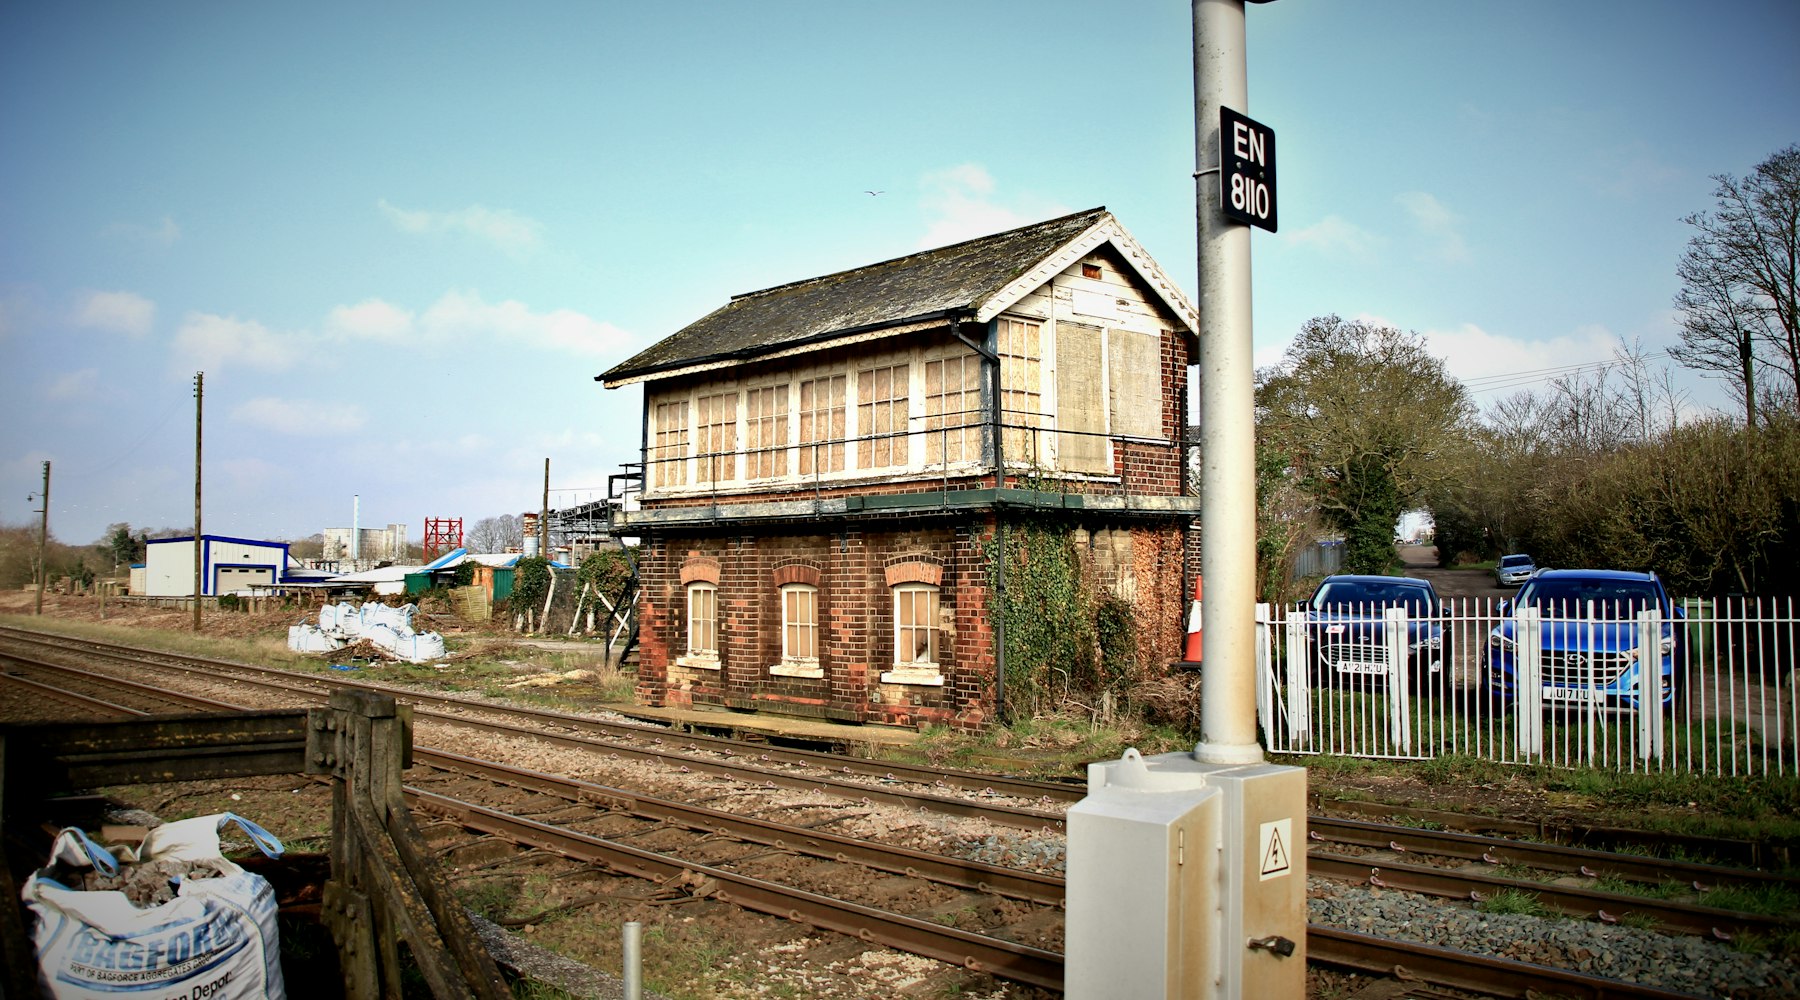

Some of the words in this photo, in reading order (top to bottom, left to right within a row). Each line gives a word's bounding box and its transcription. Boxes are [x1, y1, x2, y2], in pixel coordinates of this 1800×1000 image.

[1233, 120, 1265, 167] EN
[1230, 172, 1269, 220] 8110
[70, 964, 85, 975] PART
[86, 969, 96, 978] OF
[97, 971, 139, 982] BAGFORCE
[140, 962, 192, 981] AGGREGATES
